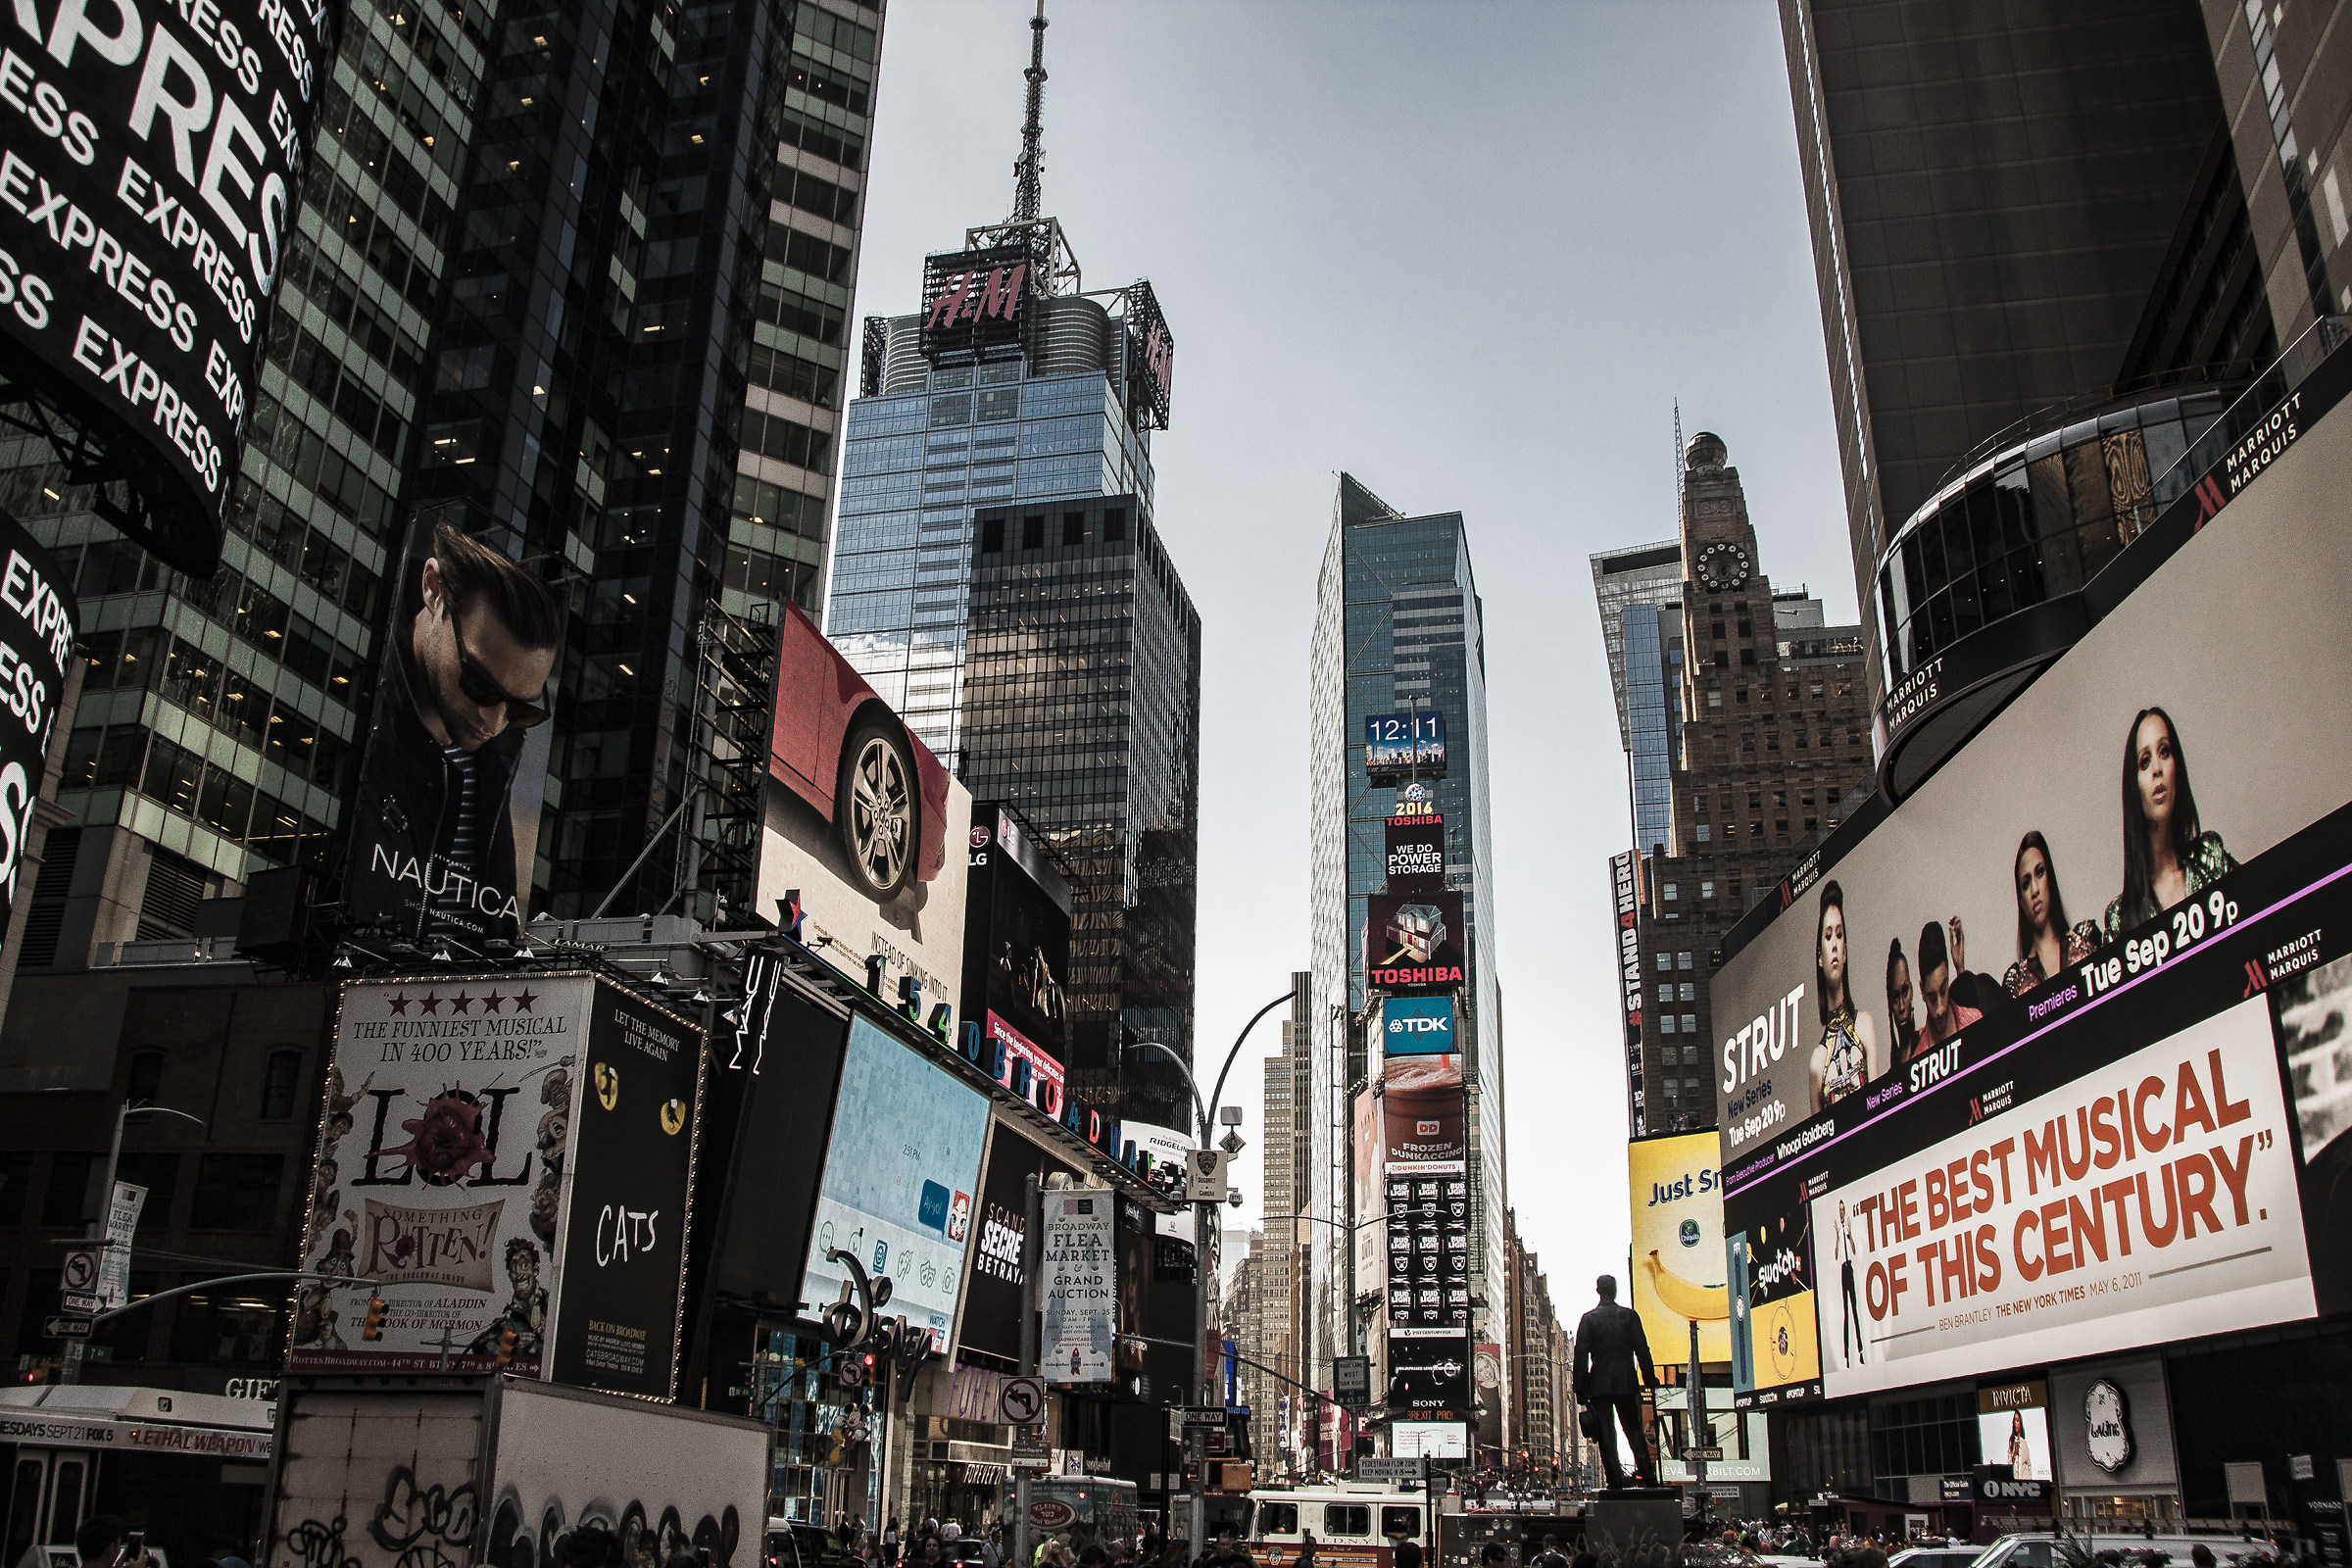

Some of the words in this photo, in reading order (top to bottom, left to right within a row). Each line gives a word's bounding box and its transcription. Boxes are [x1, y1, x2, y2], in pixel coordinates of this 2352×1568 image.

[0, 149, 198, 353] EXPRESS
[117, 156, 256, 345] EXPRESS
[926, 263, 1027, 328] H&M
[73, 315, 221, 493] EXPRESS
[2226, 392, 2301, 473] MARRIOTT
[2230, 423, 2299, 493] MARQUIS
[1886, 657, 1944, 715] MARRIOTT
[1887, 683, 1939, 735] MARQUIS
[1370, 716, 1437, 741] 12:11
[1386, 814, 1443, 826] TOSHIBA
[1396, 801, 1434, 816] 2016
[968, 852, 988, 866] LG
[1388, 853, 1442, 866] POWER
[1396, 845, 1414, 855] WE
[1416, 844, 1434, 854] DO
[1388, 864, 1442, 875] STORAGE
[1791, 849, 1822, 883] MARRIOTT
[371, 843, 521, 925] NAUTICA
[1792, 867, 1821, 898] MARQUIS
[428, 907, 484, 935] NAUTICA.COM
[871, 930, 896, 965] INSTEAD
[897, 951, 906, 971] OF
[2028, 983, 2078, 1022] Premieres
[2081, 957, 2122, 998] Tue
[2126, 928, 2171, 974] Sep
[2173, 902, 2205, 951] 20
[2208, 889, 2239, 930] 9p
[2266, 927, 2323, 966] MARRIOTT
[1371, 966, 1463, 984] TOSHIBA
[2269, 947, 2321, 981] MARQUIS
[353, 1021, 387, 1039] THE
[391, 1019, 481, 1039] FUNNIEST
[484, 1016, 567, 1037] MUSICAL
[613, 1008, 630, 1027] LET
[630, 1016, 647, 1036] THE
[647, 1025, 680, 1053] MEMORY
[1401, 1016, 1448, 1032] TDK
[624, 1030, 643, 1051] LIVE
[643, 1041, 668, 1062] AGAIN
[1721, 982, 1805, 1094] STRUT
[379, 1042, 407, 1062] IN
[411, 1043, 451, 1062] 400
[1727, 1099, 1745, 1121] New
[1745, 1079, 1772, 1109] Series
[1982, 1080, 2015, 1104] MARRIOTT
[1754, 1152, 1776, 1172] Producer
[1776, 1136, 1802, 1161] Whoopi
[1801, 1117, 1836, 1148] Goldberg
[1865, 1094, 1881, 1111] New
[1881, 1081, 1903, 1103] Series
[1910, 1038, 1962, 1094] STRUT
[1983, 1094, 2014, 1116] MARQUIS
[1419, 1124, 1438, 1133] DD
[1728, 1125, 1744, 1149] Tue
[1744, 1115, 1761, 1141] Sep
[1761, 1103, 1774, 1130] 20
[1773, 1099, 1787, 1126] 9p
[1391, 1147, 1463, 1162] DUNKACCINO
[1402, 1141, 1453, 1152] FROZEN
[1852, 1178, 1922, 1253] “THE
[1925, 1137, 2017, 1232] BEST
[2023, 1048, 2253, 1197] MUSICAL
[1648, 1172, 1693, 1207] Just
[1807, 1170, 1830, 1187] MARRIOTT
[383, 1207, 483, 1225] SOMETHING
[1048, 1222, 1109, 1232] BROADWAY
[1864, 1250, 1910, 1323] OF
[1916, 1223, 2002, 1308] THIS
[2012, 1128, 2275, 1283] CENTURY.”
[596, 1203, 660, 1267] CATS
[1054, 1233, 1103, 1248] FLEA
[1046, 1250, 1109, 1262] MARKET
[1758, 1247, 1795, 1289] swatch
[1054, 1275, 1103, 1286] GRAND
[68, 1297, 80, 1306] ONE
[80, 1298, 94, 1309] WAY
[434, 1298, 487, 1309] ALADDIN
[1048, 1289, 1109, 1299] AUCTION
[1938, 1318, 1954, 1332] BEN
[1954, 1306, 1994, 1329] BRANTLEY
[1995, 1302, 2012, 1318] THE
[2012, 1298, 2034, 1314] NEW
[2034, 1292, 2059, 1309] YORK
[2058, 1285, 2086, 1304] TIMES
[2088, 1280, 2110, 1298] MAY
[2111, 1277, 2122, 1293] 6,
[2122, 1271, 2143, 1290] 2011
[58, 1322, 72, 1331] ONE
[73, 1323, 87, 1332] WAY
[1991, 1385, 2033, 1407] INVICTA
[1185, 1412, 1202, 1421] ONE
[1203, 1412, 1222, 1421] WAY
[46, 1424, 74, 1440] SEPT
[74, 1426, 86, 1441] 21
[86, 1428, 106, 1442] FOX
[106, 1430, 114, 1442] 5
[133, 1429, 191, 1449] LETHAL
[194, 1436, 255, 1454] WEAPON
[962, 1463, 996, 1486] FOREVER
[2001, 1482, 2041, 1497] NYC
[1033, 1502, 1061, 1512] KLEIN'S
[2307, 1499, 2343, 1509] VORNADO
